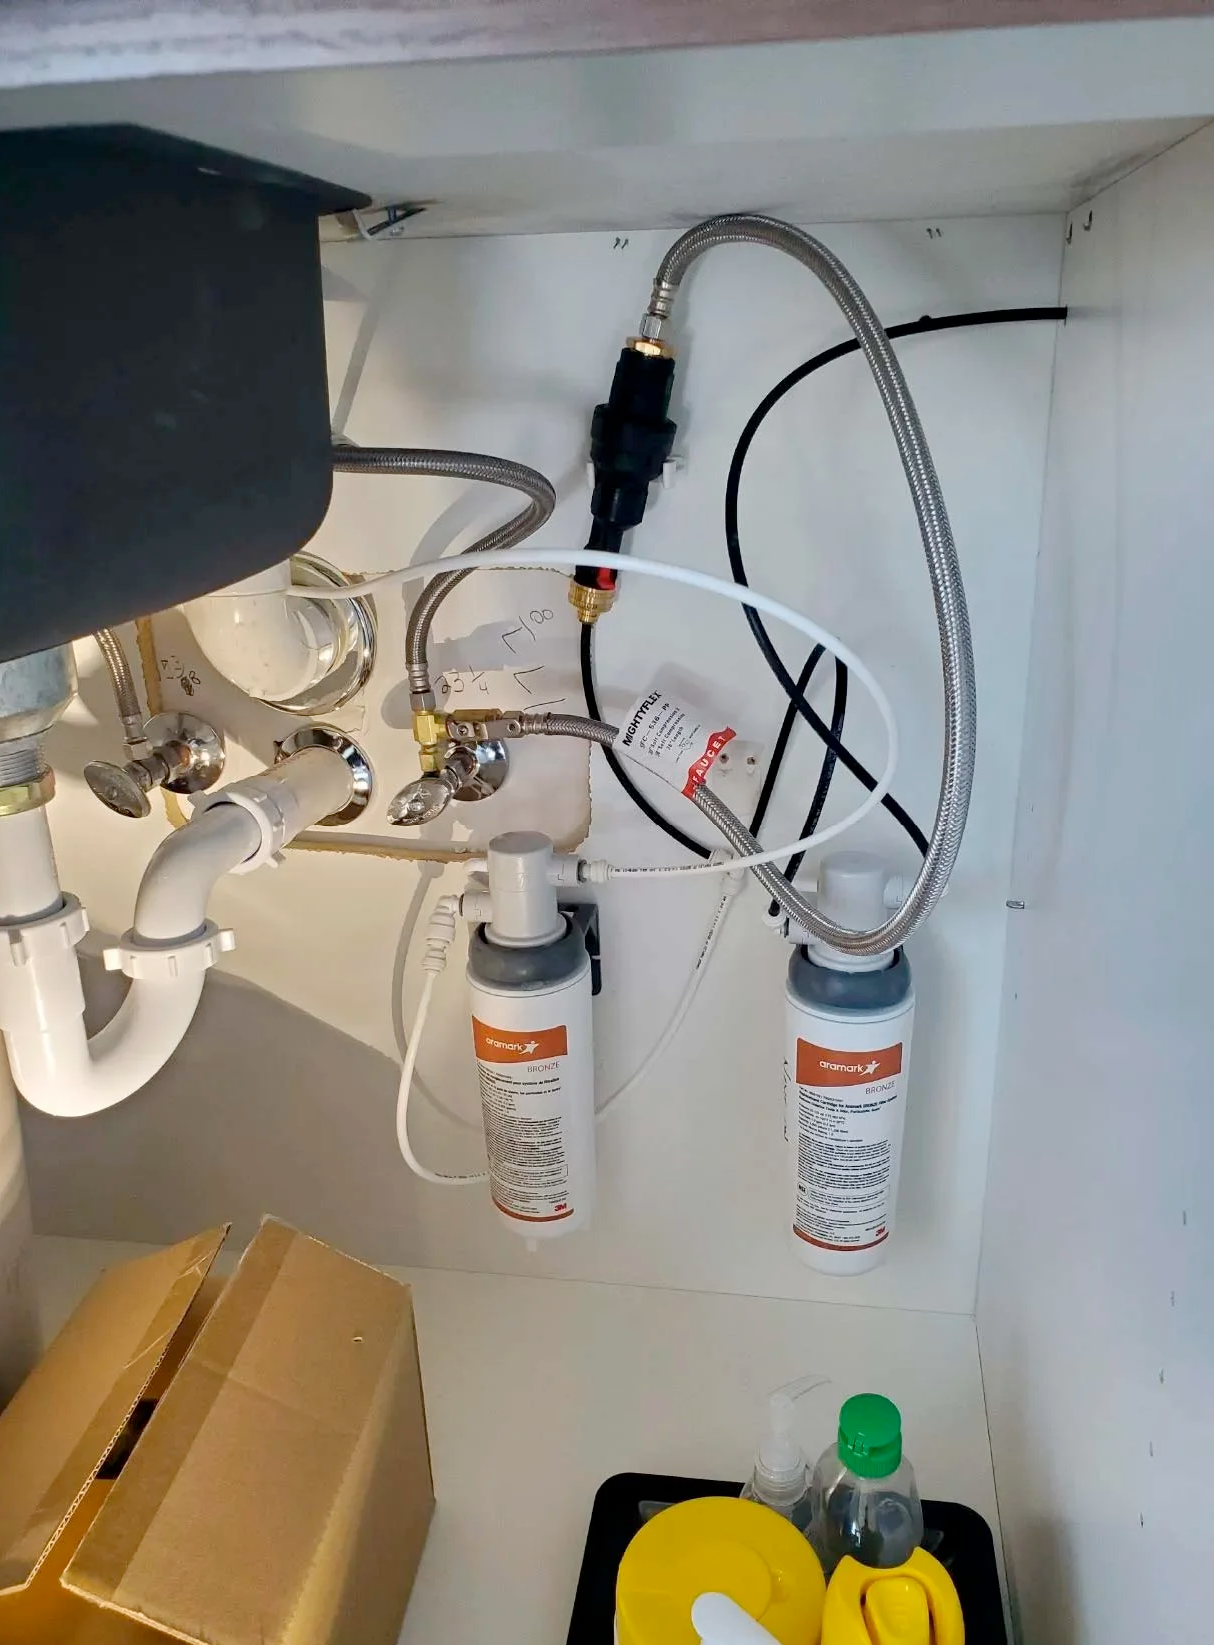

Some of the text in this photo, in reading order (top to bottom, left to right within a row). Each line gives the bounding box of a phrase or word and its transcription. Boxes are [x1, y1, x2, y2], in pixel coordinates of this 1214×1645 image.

[621, 689, 662, 747] MIGHTYFLEX
[692, 735, 727, 782] FAUCET
[485, 1037, 523, 1052] aramark
[527, 1061, 560, 1073] BRONZE
[819, 1060, 864, 1073] aramark
[865, 1081, 896, 1095] BRONZE
[554, 1202, 568, 1212] 3M
